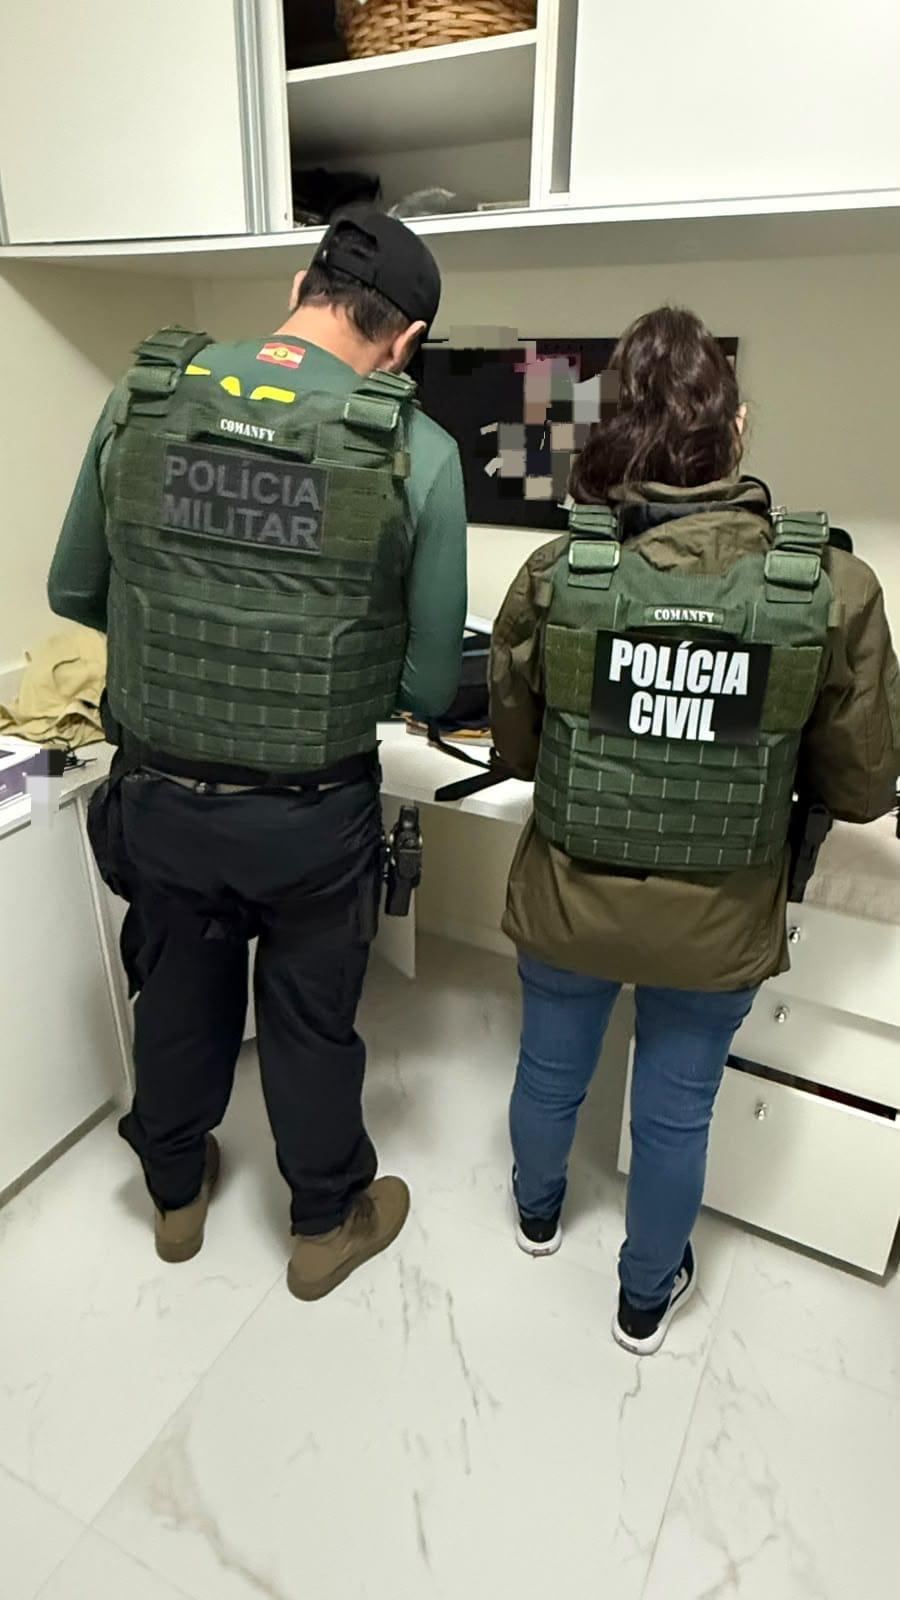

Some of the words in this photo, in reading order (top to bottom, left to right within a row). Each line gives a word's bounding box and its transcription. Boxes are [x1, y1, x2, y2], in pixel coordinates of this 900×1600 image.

[220, 419, 275, 441] COMANFY
[165, 456, 321, 511] POLÍCIA
[161, 495, 320, 549] MILITAR
[654, 608, 715, 623] COMANFY
[609, 638, 750, 695] POLÍCIA
[629, 690, 716, 742] CIVIL
